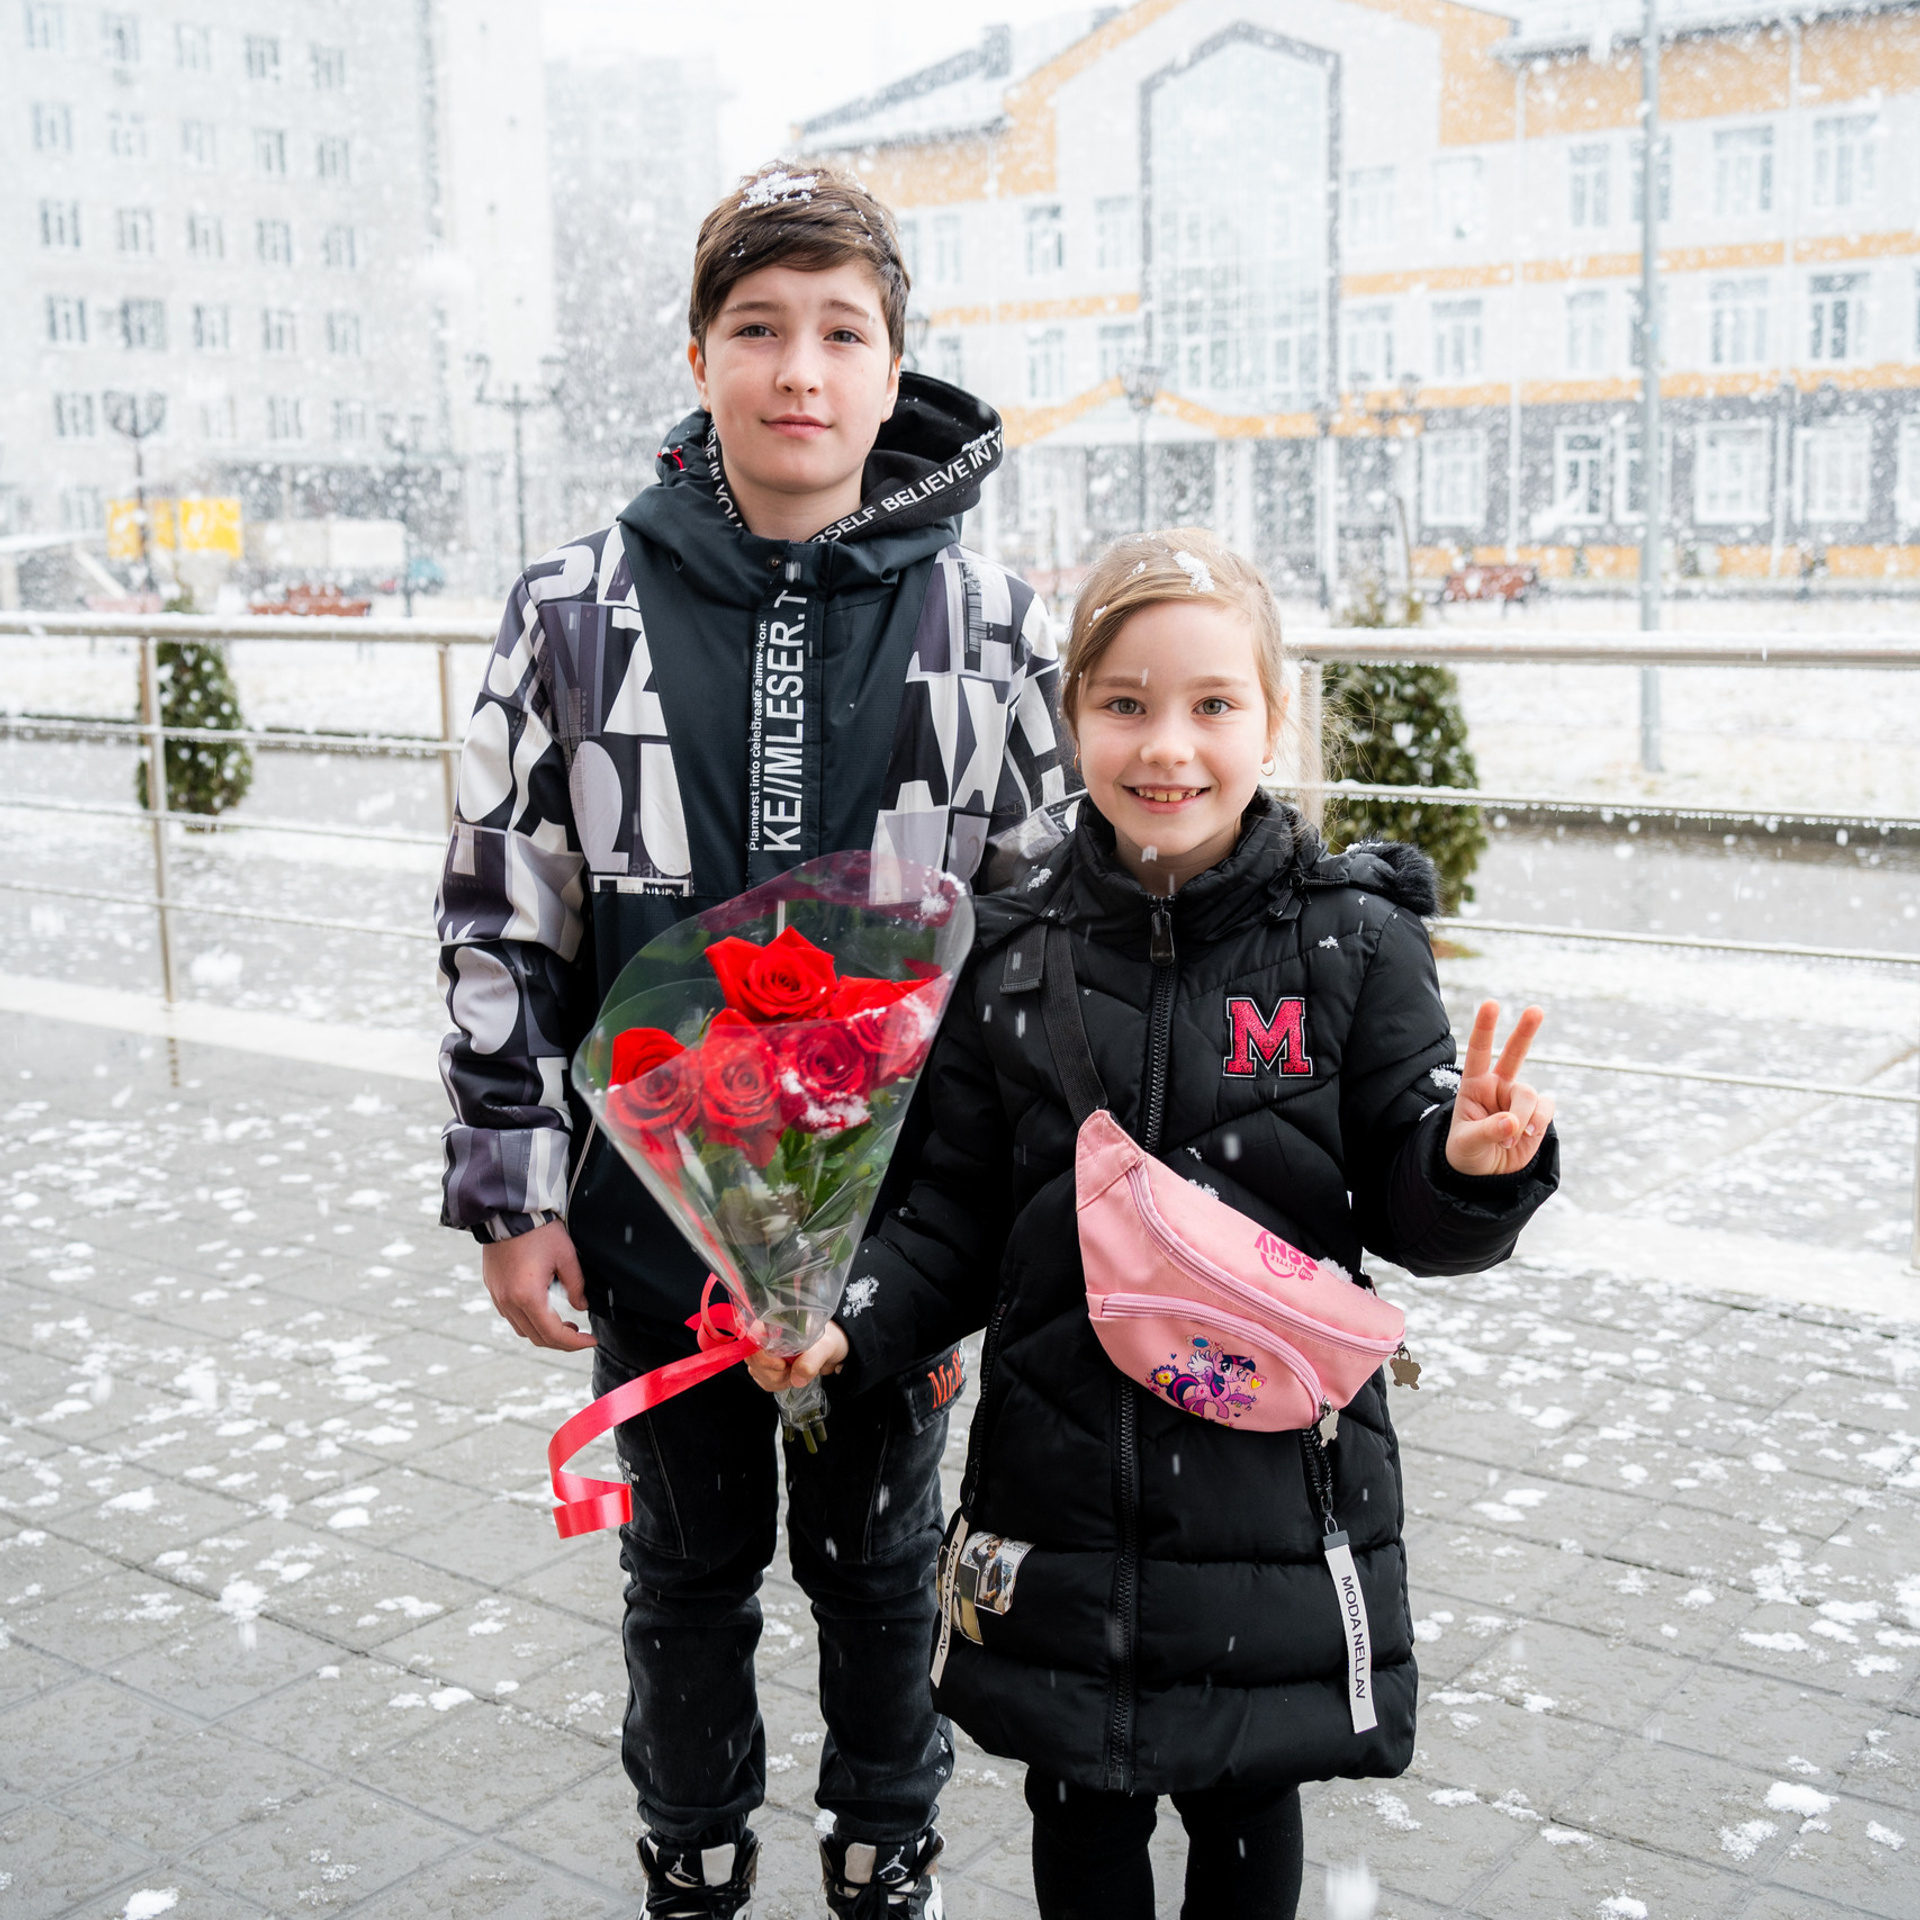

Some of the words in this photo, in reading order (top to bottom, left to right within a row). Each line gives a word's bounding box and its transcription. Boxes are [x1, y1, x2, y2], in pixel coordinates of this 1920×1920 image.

[881, 458, 970, 513] BELIEVE
[968, 445, 993, 470] IN
[750, 760, 761, 787] into
[1223, 997, 1313, 1077] M
[1341, 1576, 1362, 1631] MODA
[1353, 1632, 1366, 1699] NELLAV
